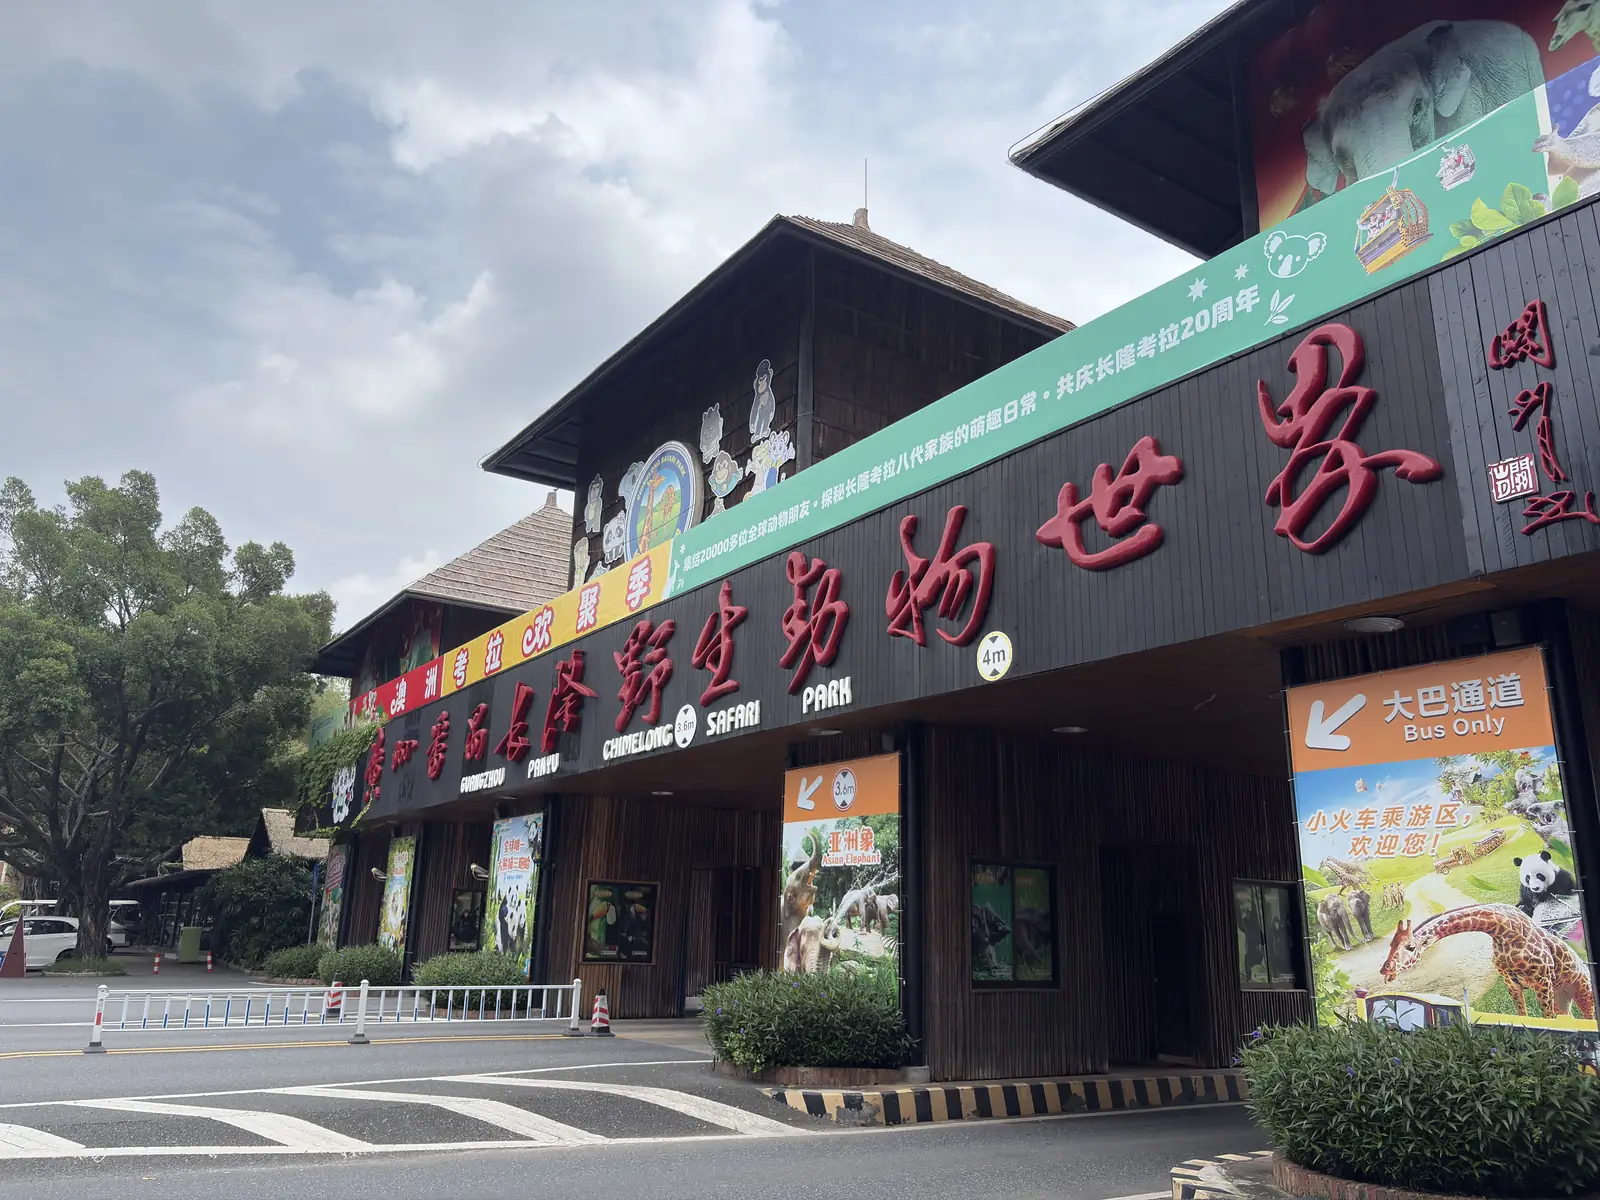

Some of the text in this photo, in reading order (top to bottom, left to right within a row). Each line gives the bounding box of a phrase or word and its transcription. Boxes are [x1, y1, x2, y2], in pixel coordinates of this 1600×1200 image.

[982, 646, 1006, 664] 4m
[1383, 673, 1525, 724] 大巴通道
[460, 676, 853, 793] GUANGZHOU PANYU CHIMELONG SAFARI PARK
[677, 719, 695, 733] 3.6m
[1404, 714, 1506, 742] Bus Only
[834, 781, 855, 796] 3.6m
[829, 826, 875, 853] 亚洲象
[822, 852, 881, 865] Asian Elephant
